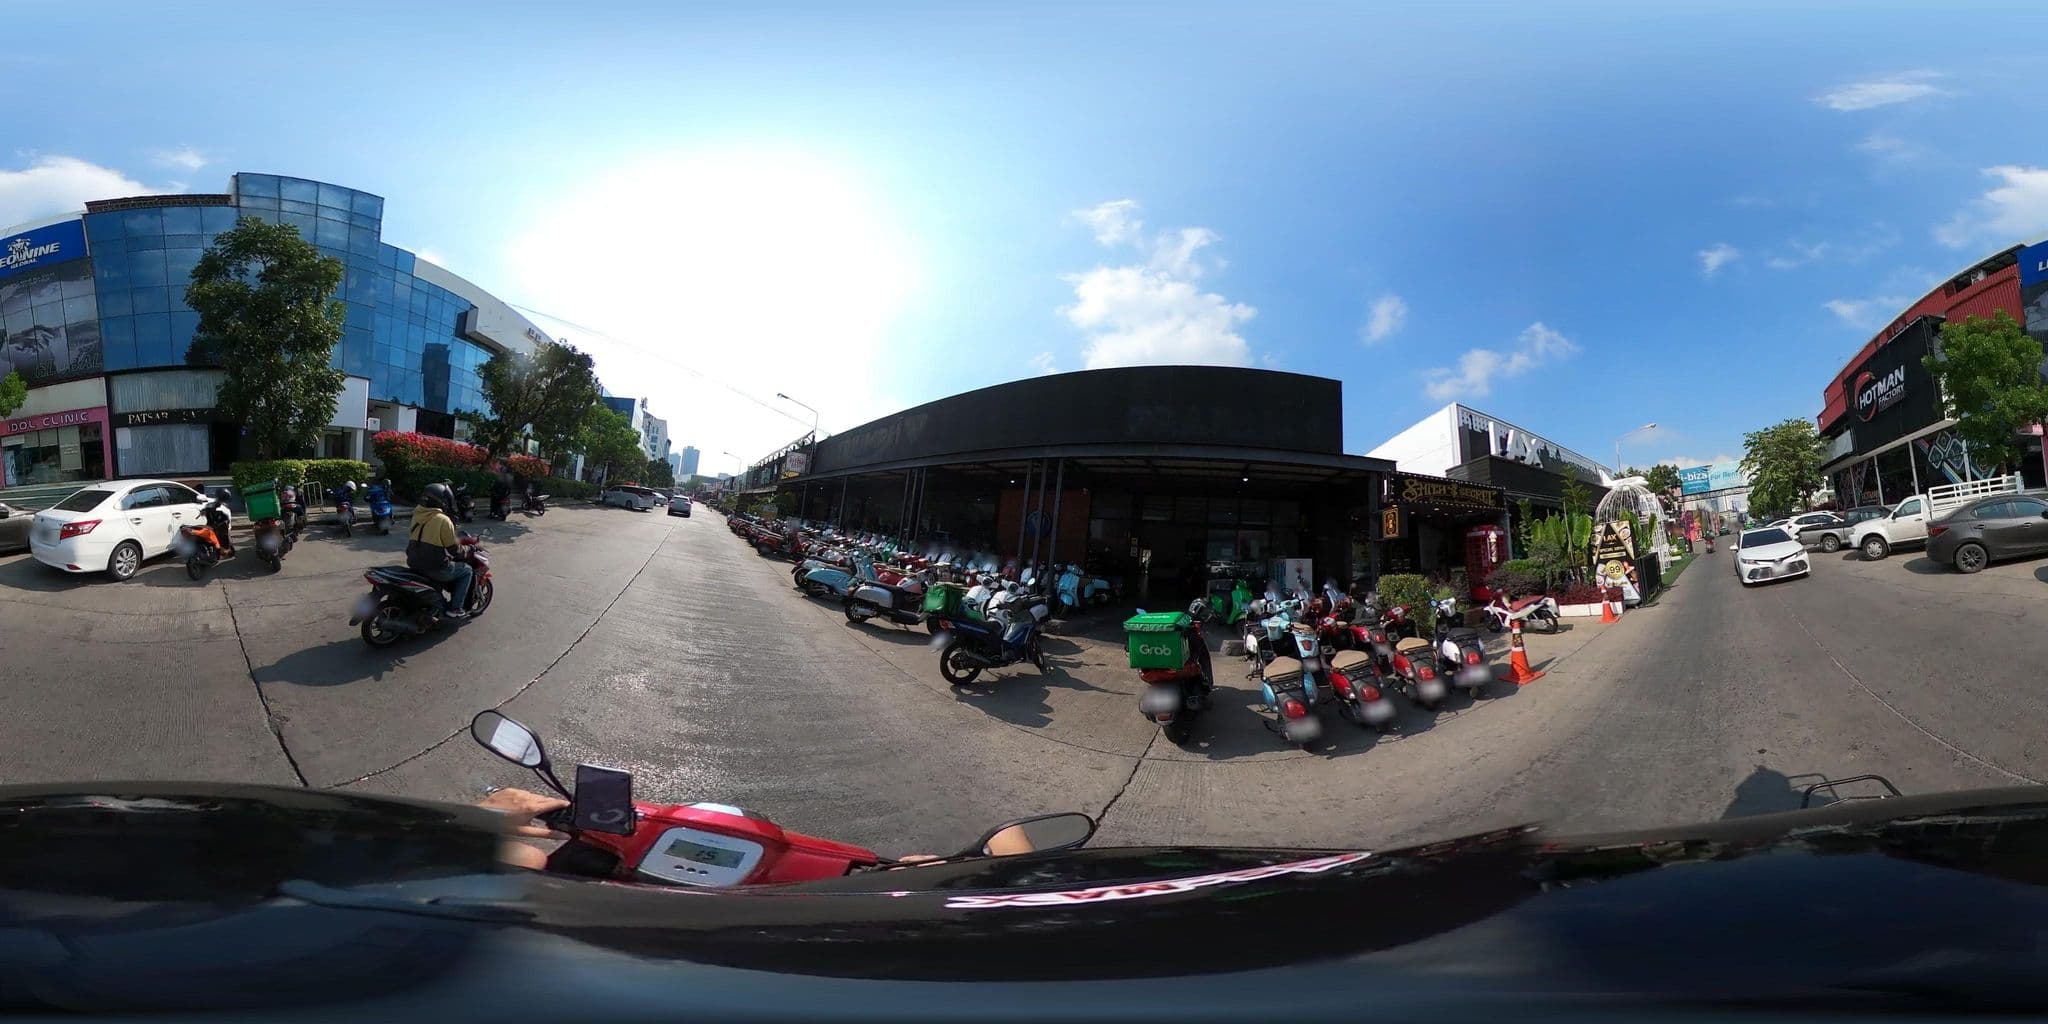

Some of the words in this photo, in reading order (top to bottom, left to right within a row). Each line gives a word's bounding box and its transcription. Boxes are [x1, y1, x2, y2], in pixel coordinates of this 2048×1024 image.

[1860, 365, 1904, 410] HOTMAN
[1879, 383, 1904, 405] FACTORY
[8, 421, 35, 432] IDOL
[43, 412, 88, 426] CLINIC
[1489, 421, 1544, 470] LAX
[1609, 565, 1620, 574] 99
[1140, 644, 1171, 656] Grab
